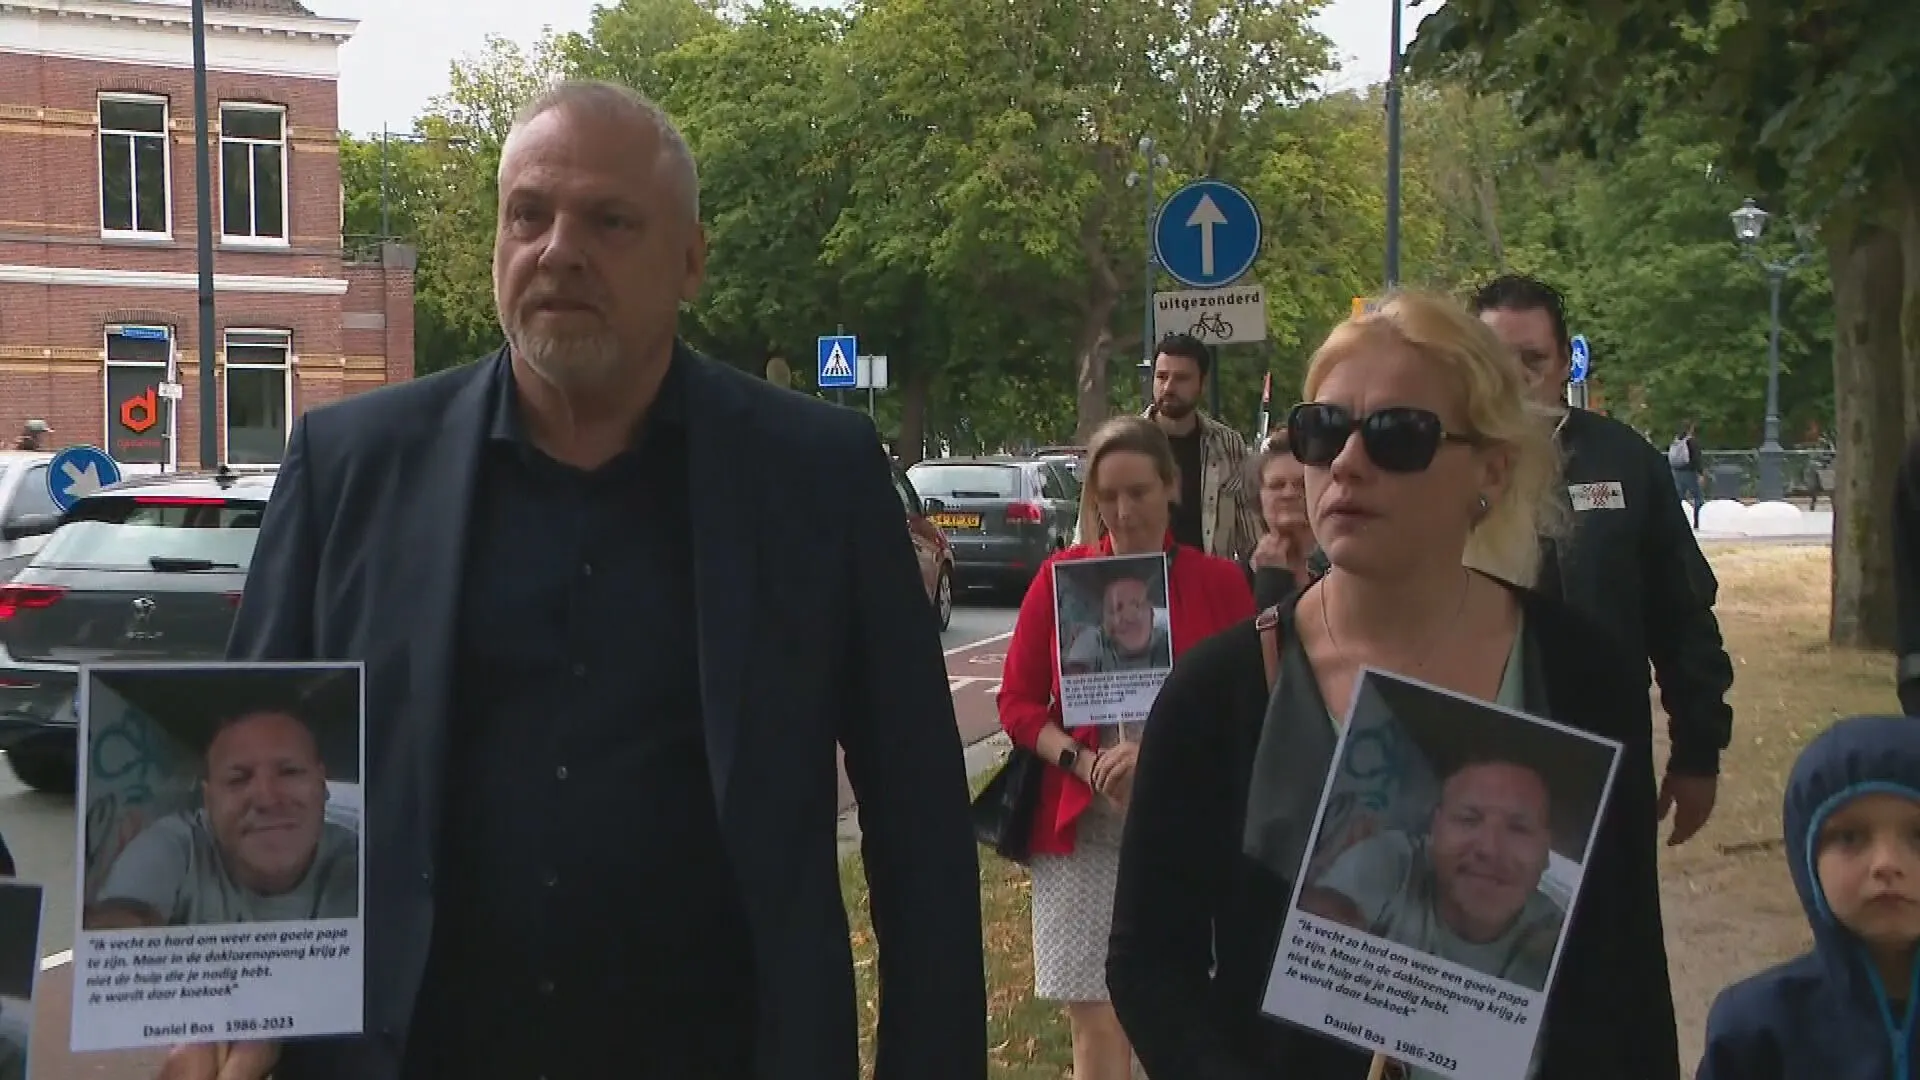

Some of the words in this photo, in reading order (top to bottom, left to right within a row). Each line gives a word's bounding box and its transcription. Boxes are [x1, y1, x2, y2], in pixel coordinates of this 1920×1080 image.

[1160, 291, 1260, 311] uitgezonderd
[111, 936, 143, 949] vecht
[147, 938, 161, 948] zo
[165, 934, 194, 946] hard
[197, 935, 217, 944] om
[221, 934, 250, 943] weer
[254, 932, 277, 942] een
[280, 928, 314, 944] goeie
[316, 928, 348, 942] papa
[88, 957, 100, 968] te
[133, 955, 167, 965] Maar
[171, 953, 183, 964] in
[187, 951, 201, 964] de
[205, 946, 305, 963] daklozenopvang
[309, 945, 336, 958] krijg
[338, 945, 350, 957] je
[1315, 928, 1345, 943] vecht
[1346, 938, 1359, 949] zo
[1361, 941, 1390, 958] hard
[1389, 953, 1408, 965] om
[1411, 960, 1439, 975] weer
[1441, 970, 1462, 984] een
[1463, 980, 1497, 996] goeie
[1498, 991, 1529, 1007] papa
[1285, 966, 1298, 978] Je
[1300, 972, 1333, 990] wordt
[1335, 984, 1361, 999] daar
[1288, 952, 1309, 965] niet
[1311, 960, 1326, 970] de
[1328, 964, 1352, 980] hulp
[1354, 974, 1372, 986] die
[1372, 980, 1385, 991] je
[1386, 985, 1420, 1005] nodig
[1291, 935, 1304, 946] te
[1330, 947, 1361, 966] Maar
[1363, 960, 1375, 970] in
[1376, 964, 1391, 976] de
[1392, 970, 1485, 1011] daklozenopvang
[1487, 1002, 1513, 1021] krijg
[1514, 1012, 1528, 1025] je
[143, 1024, 186, 1037] Daniel
[191, 1023, 214, 1035] Bos
[226, 1016, 294, 1033] 1986-2023
[1324, 1014, 1362, 1037] Daniel
[1364, 1027, 1386, 1045] Bos
[1395, 1039, 1457, 1071] 1986-2023
